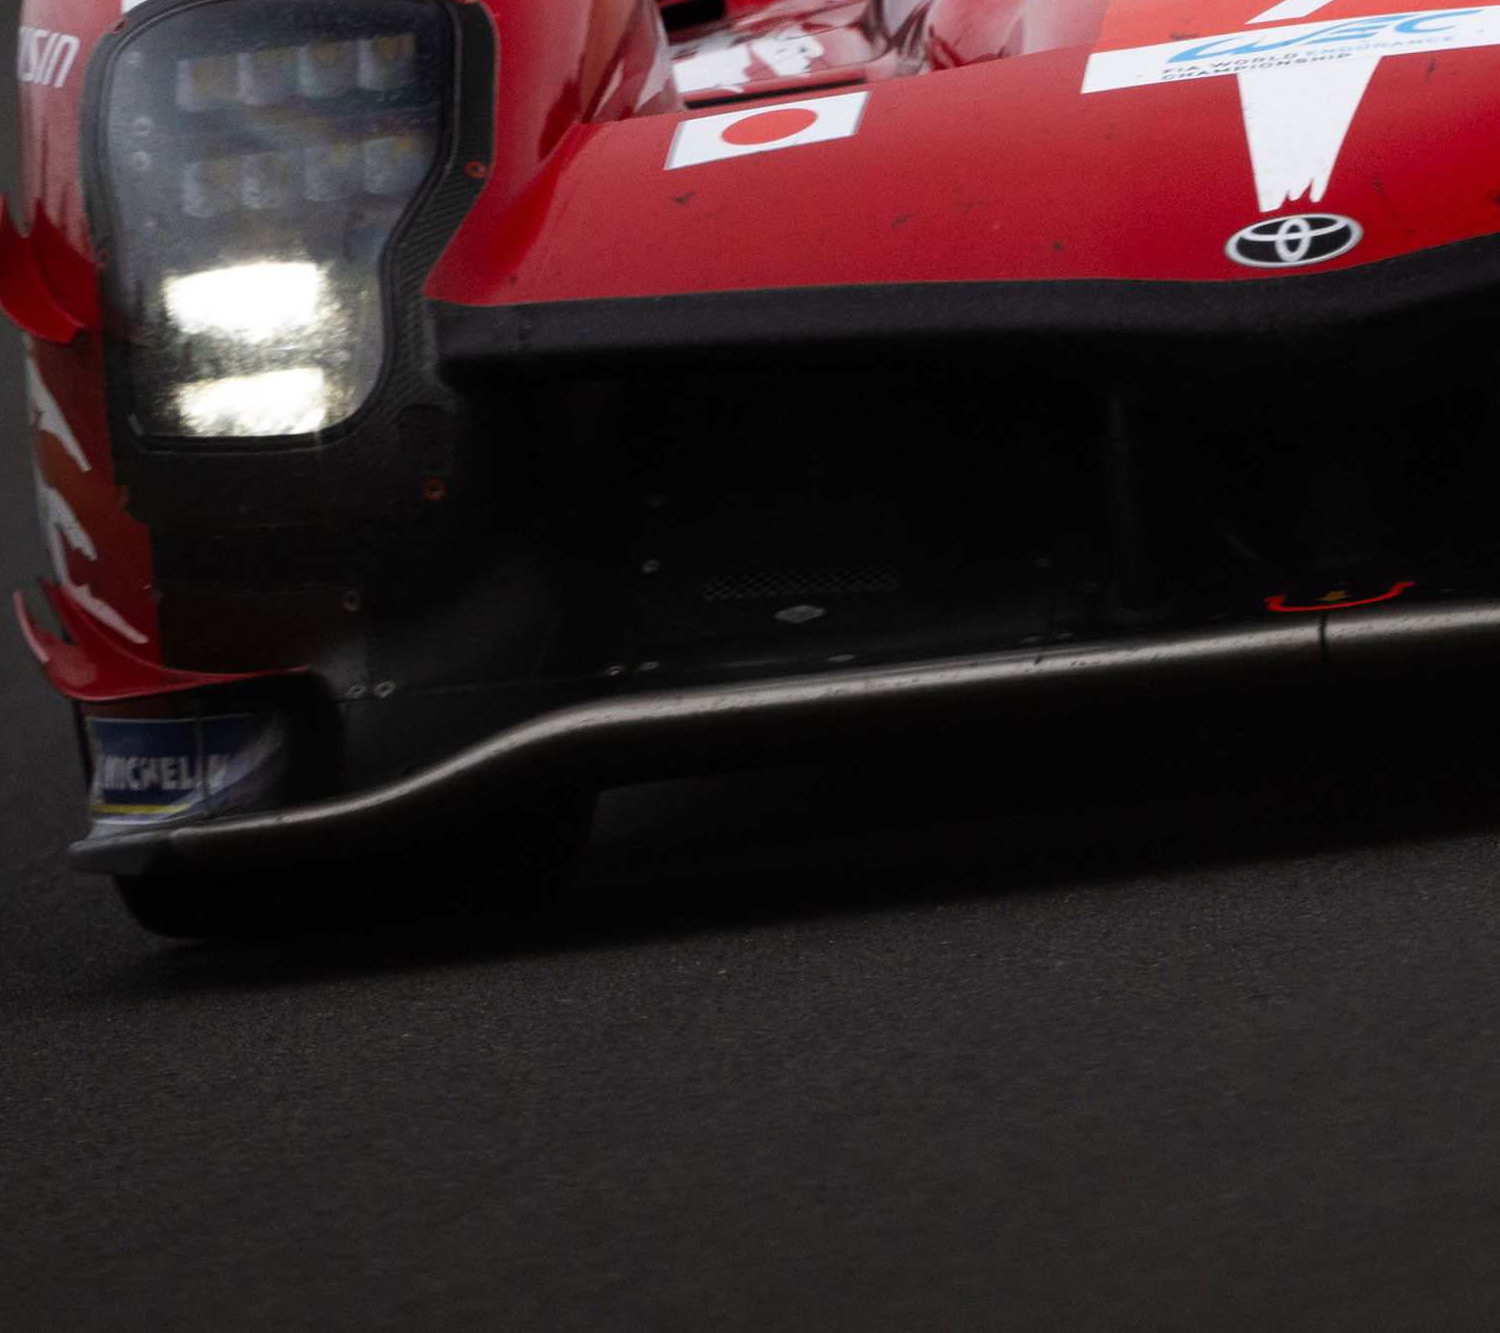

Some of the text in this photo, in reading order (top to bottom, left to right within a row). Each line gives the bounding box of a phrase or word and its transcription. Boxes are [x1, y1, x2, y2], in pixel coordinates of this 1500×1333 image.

[1161, 34, 1457, 76] FIA WORLD ENDURANCE
[1166, 9, 1485, 64] WEC
[1160, 52, 1352, 82] CHAMPIONSHIP
